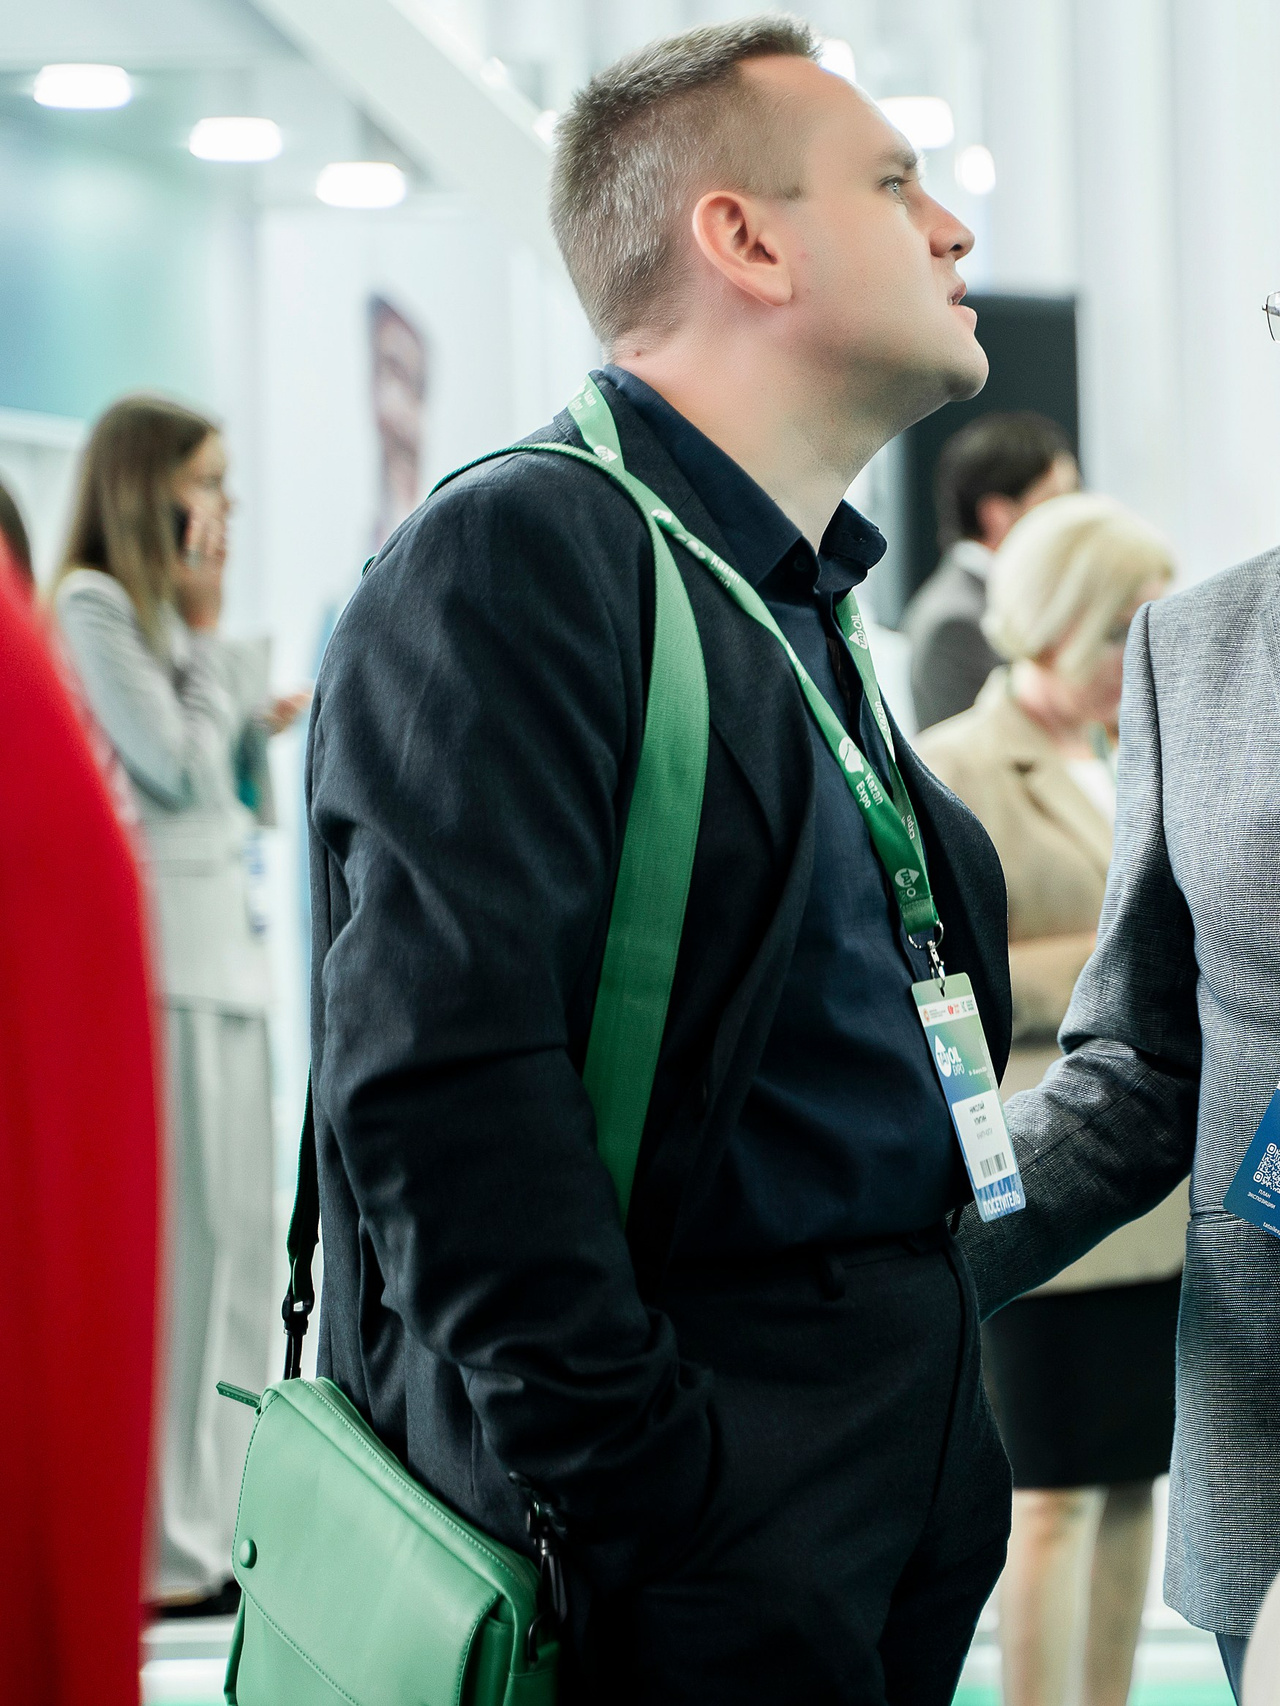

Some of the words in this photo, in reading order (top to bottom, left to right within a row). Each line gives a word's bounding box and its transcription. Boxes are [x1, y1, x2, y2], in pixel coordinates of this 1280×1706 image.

[855, 780, 871, 809] Expo
[864, 772, 884, 806] Kazan
[982, 1190, 1021, 1216] ПОСЕТИТЕЛЬ
[1258, 1189, 1271, 1199] ПЛАН
